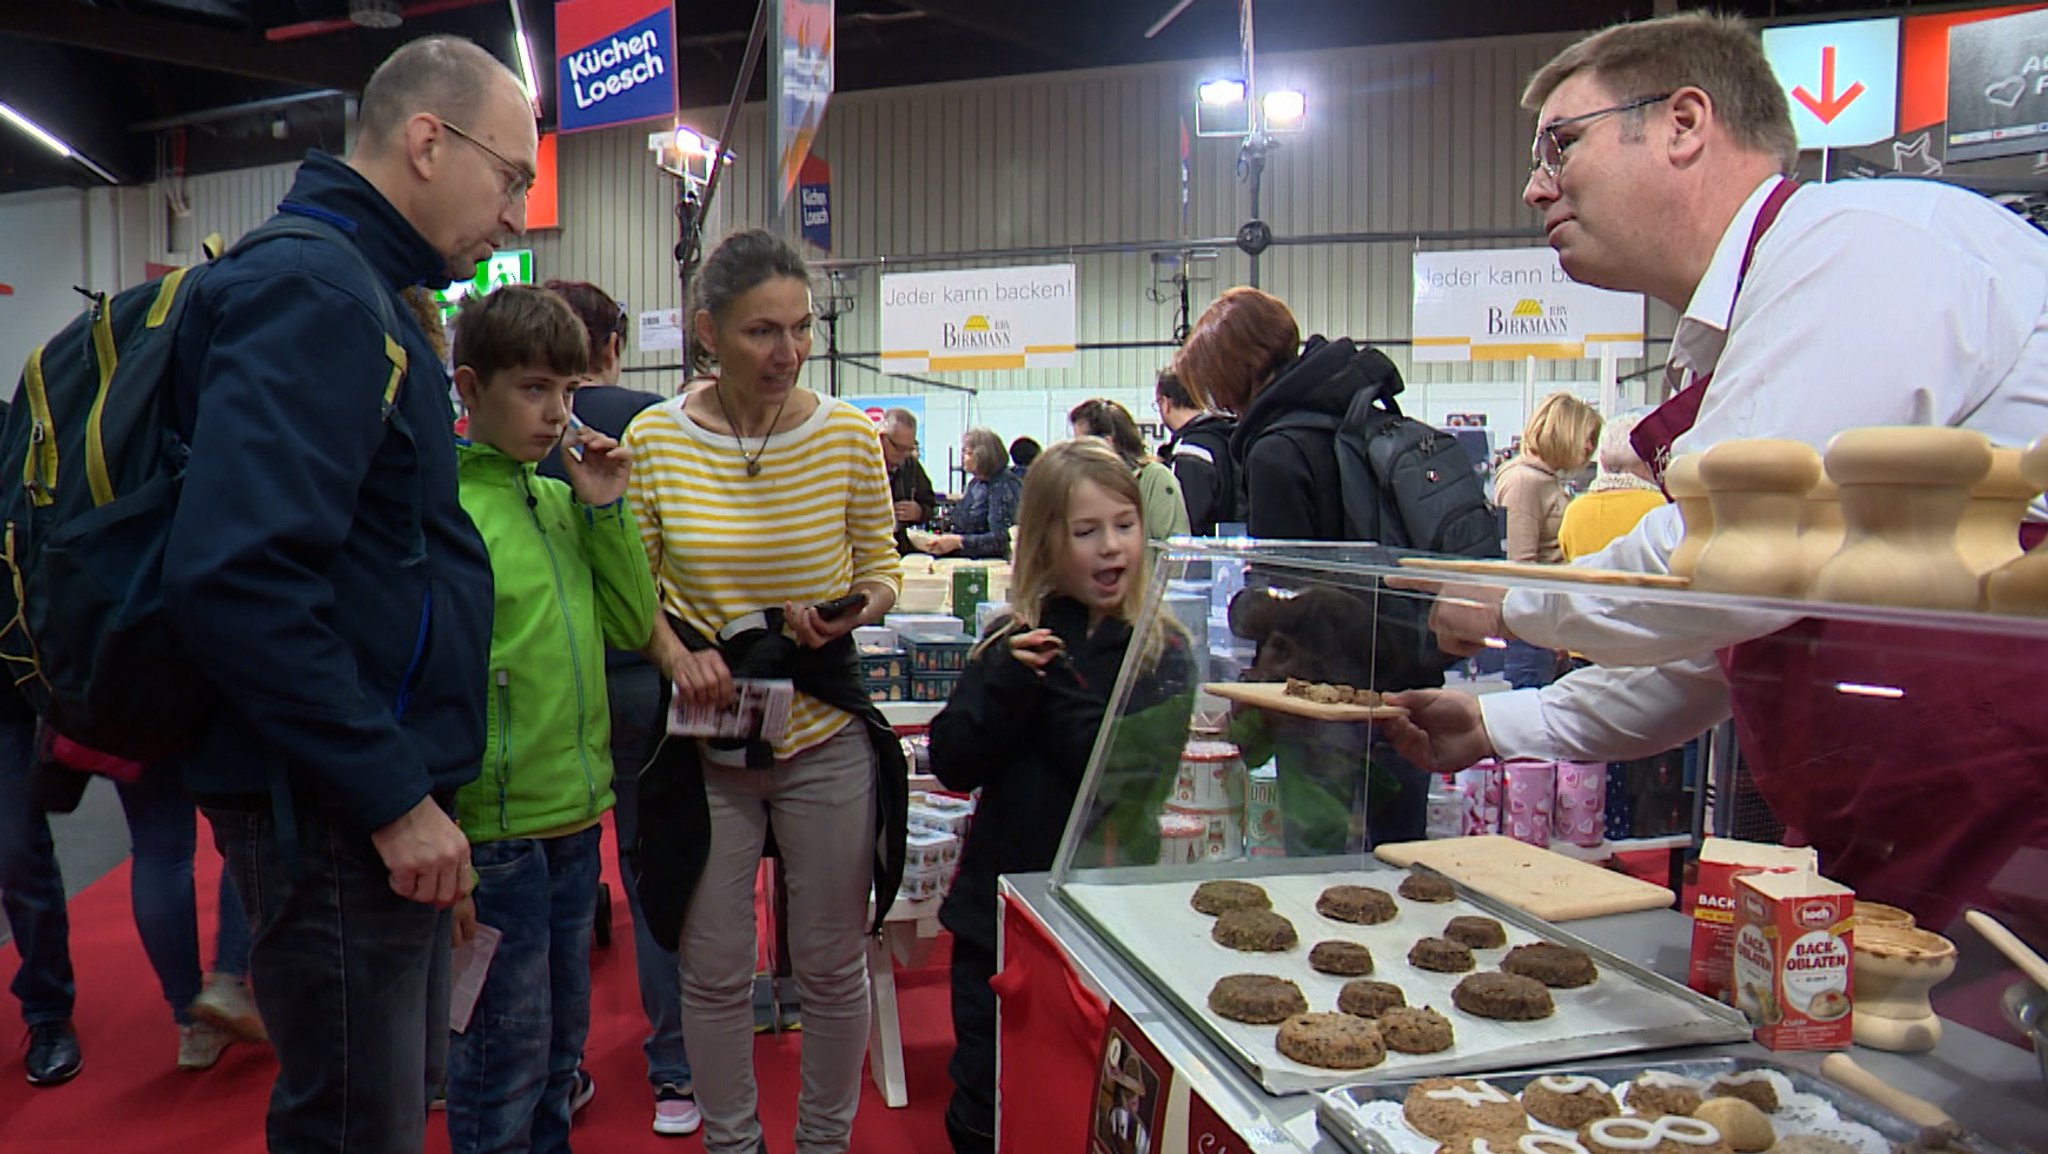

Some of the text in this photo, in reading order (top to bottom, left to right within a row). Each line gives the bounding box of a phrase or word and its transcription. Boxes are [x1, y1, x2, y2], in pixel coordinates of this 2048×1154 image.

[568, 30, 657, 81] Küchen
[574, 51, 664, 109] Loesch
[1489, 266, 1542, 285] kann
[885, 280, 1072, 306] Jeder kann backen!
[1488, 306, 1569, 336] BIRKMANN
[943, 322, 1012, 349] BIRKMANN
[1698, 893, 1736, 910] BACK
[1796, 941, 1838, 956] BACK-
[1786, 953, 1847, 971] OBLATEN
